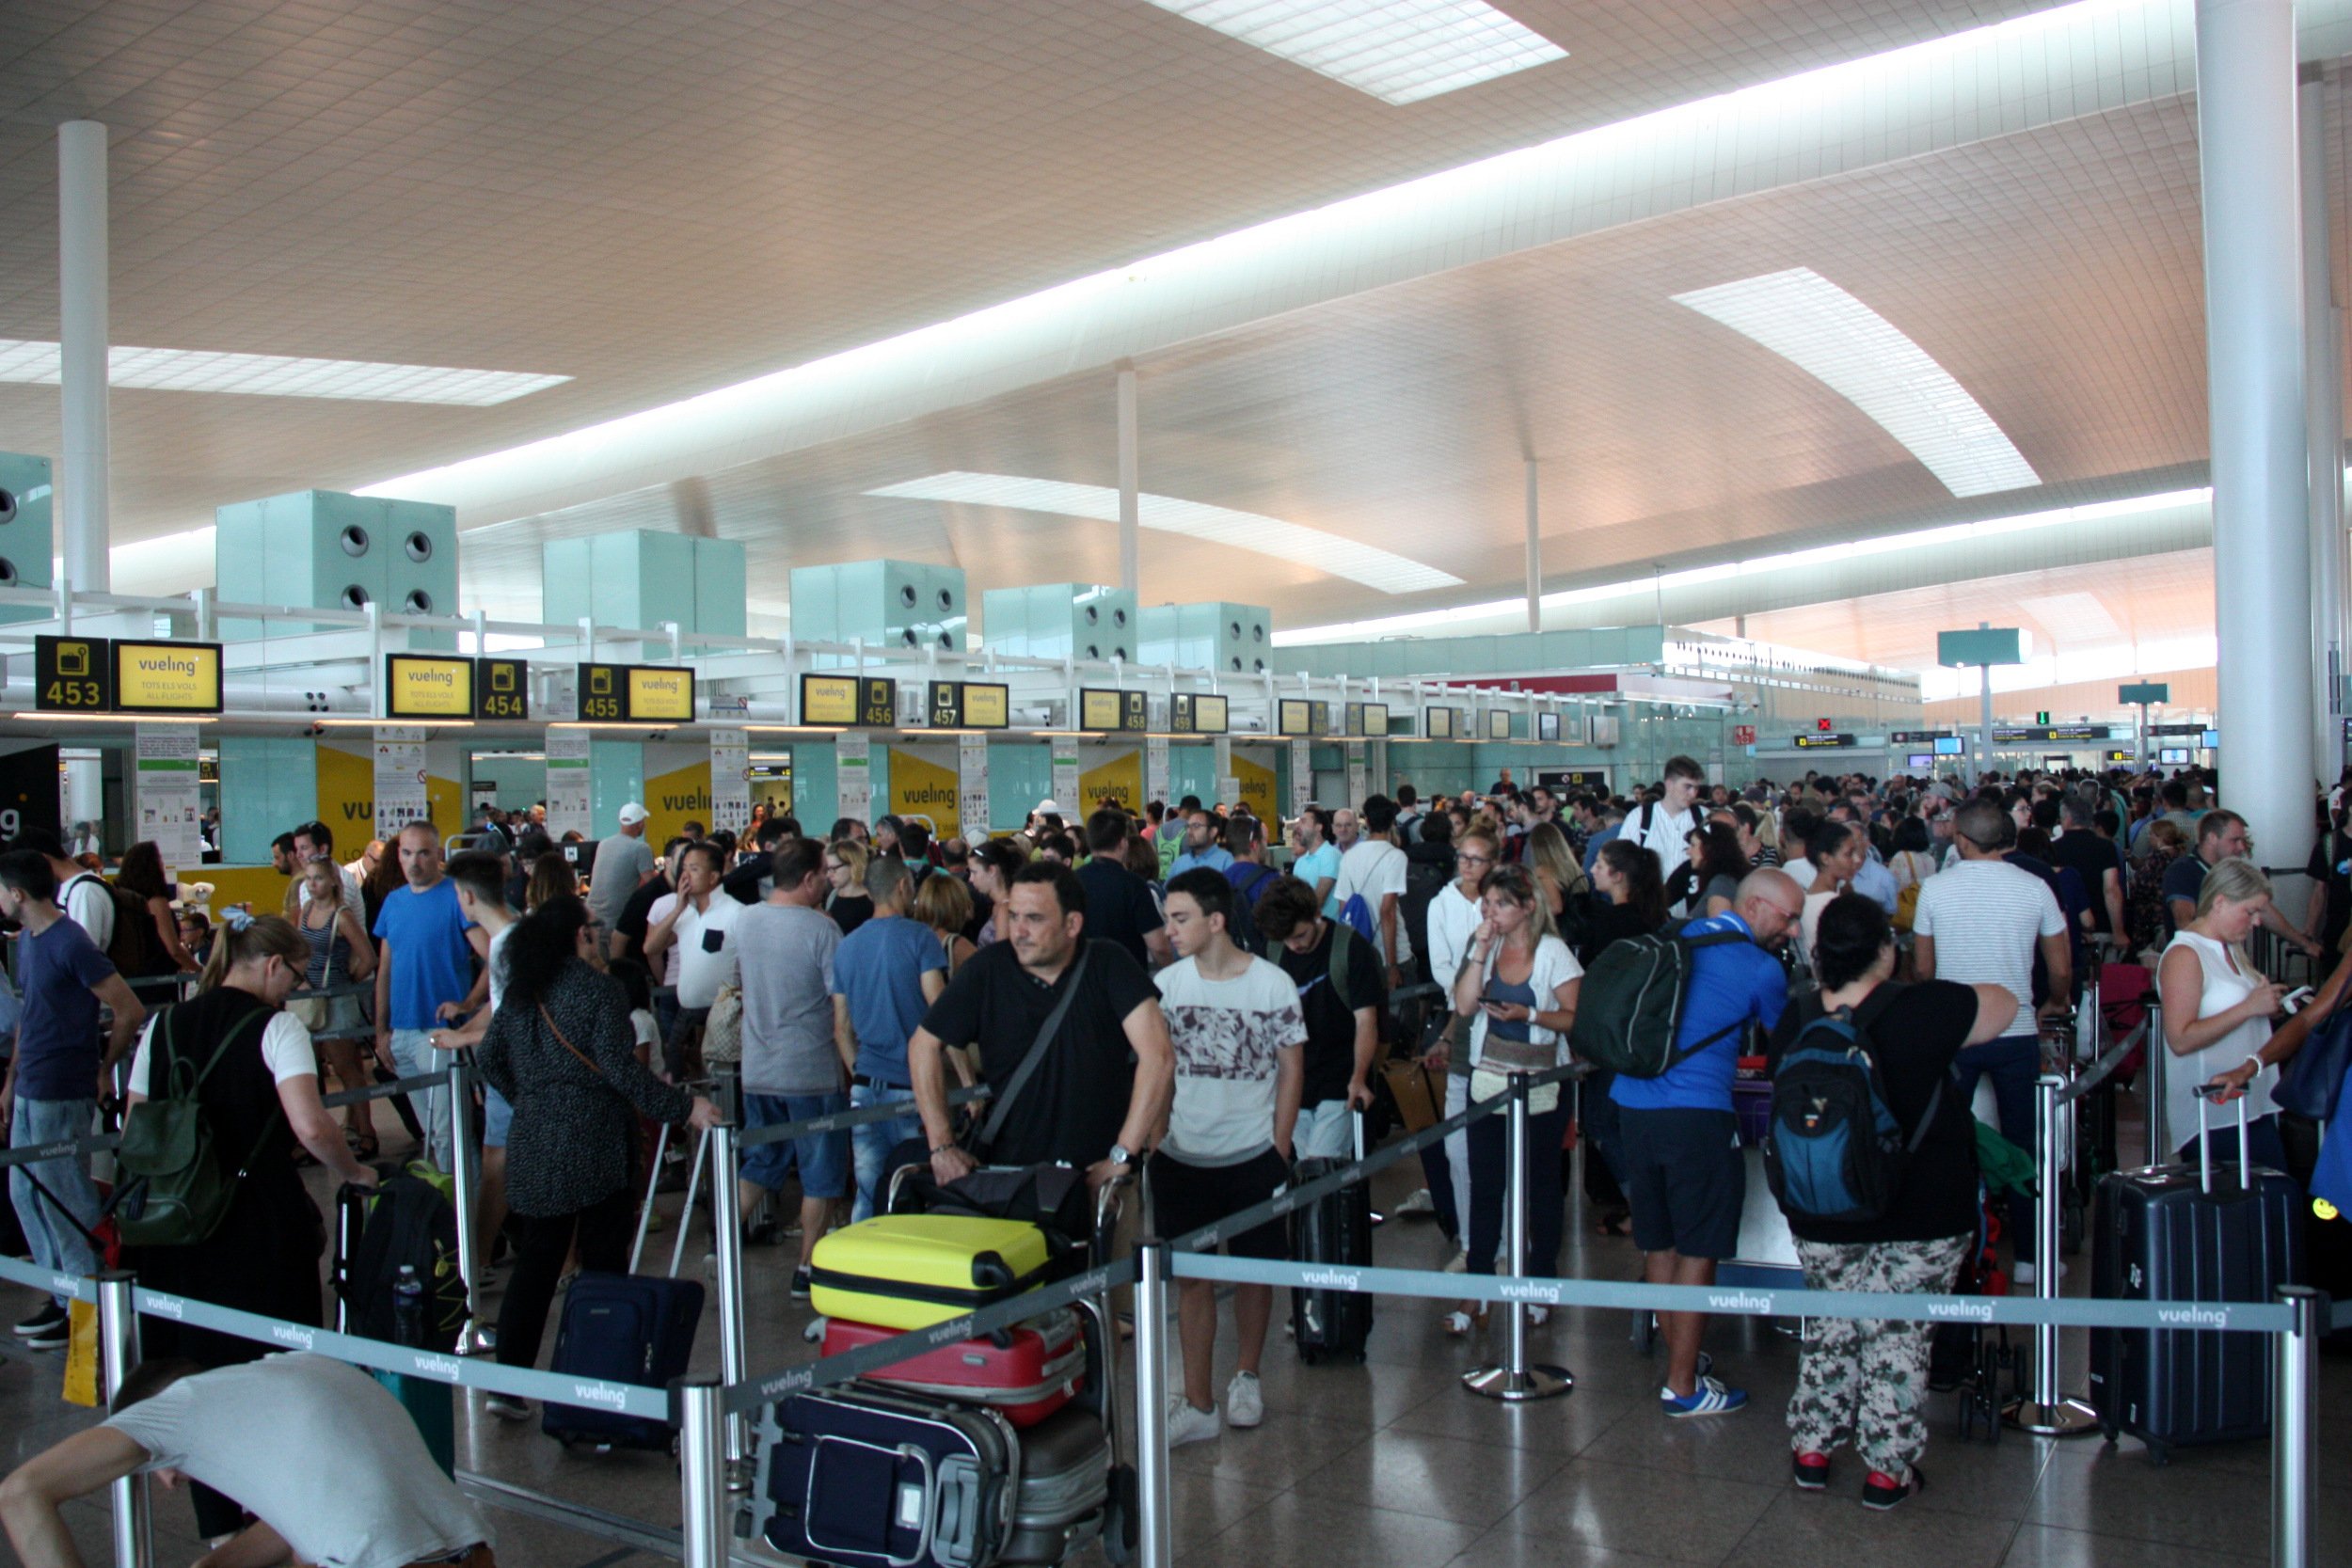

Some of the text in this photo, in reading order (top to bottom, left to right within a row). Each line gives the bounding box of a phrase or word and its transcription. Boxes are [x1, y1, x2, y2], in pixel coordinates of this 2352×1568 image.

[139, 655, 196, 676] vueling
[142, 681, 197, 690] TOTS ELS VOLS
[408, 668, 453, 686] vueling
[642, 677, 677, 693] vueling
[47, 681, 100, 705] 453
[485, 695, 522, 715] 454
[584, 698, 618, 717] 455
[866, 706, 892, 723] 456
[933, 709, 957, 725] 457
[1126, 714, 1145, 730] 458
[903, 783, 956, 809] vueling
[1088, 780, 1129, 803] vueling
[1238, 777, 1267, 799] ueling
[40, 1143, 77, 1157] vueling
[53, 1273, 78, 1295] vueling
[1070, 1272, 1107, 1294] vueling
[1302, 1269, 1358, 1291] vueling
[1500, 1281, 1559, 1304] vueling
[1708, 1292, 1771, 1314] vueling
[146, 1295, 183, 1318] vueling
[1929, 1300, 1993, 1321] vueling
[2158, 1305, 2227, 1328] vueling
[273, 1323, 313, 1350] vueling
[929, 1318, 973, 1344] vueling
[415, 1354, 459, 1380] vueling
[761, 1369, 813, 1396] vueling
[575, 1382, 626, 1409] vueling
